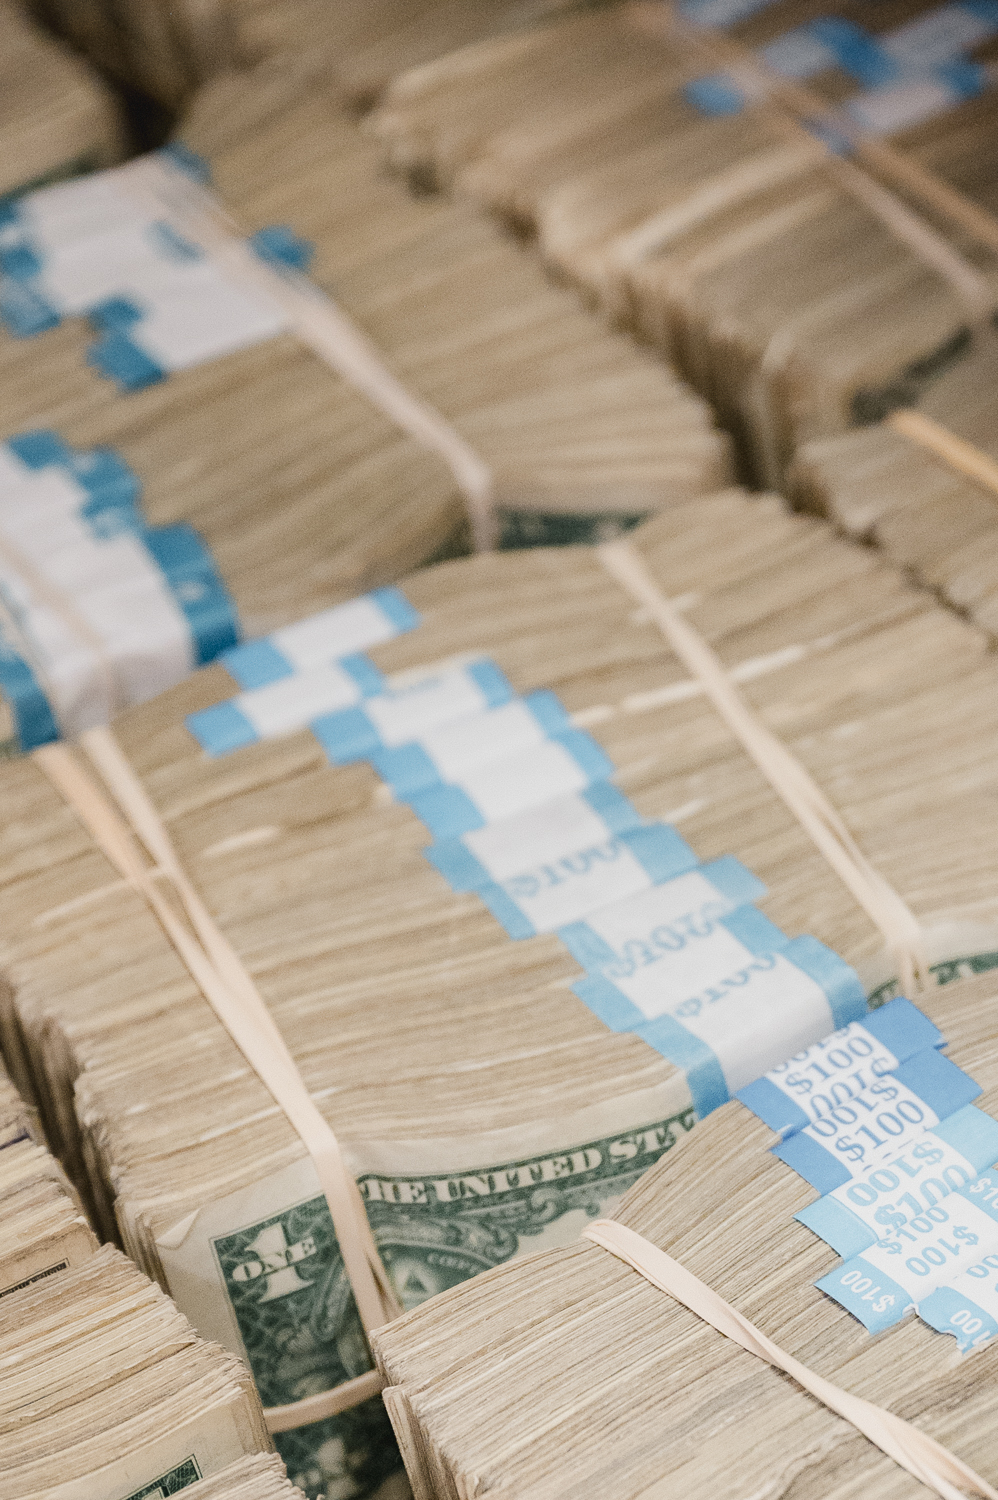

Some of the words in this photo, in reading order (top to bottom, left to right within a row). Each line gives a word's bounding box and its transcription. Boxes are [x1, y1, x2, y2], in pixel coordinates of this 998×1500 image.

[785, 1036, 873, 1095] $100
[811, 1079, 899, 1138] $100
[835, 1099, 924, 1163] $100
[433, 1147, 603, 1202] UNITED
[846, 1140, 945, 1207] $100
[877, 1206, 950, 1255] $100
[905, 1225, 979, 1277] $100
[231, 1237, 318, 1283] ONE
[840, 1269, 896, 1312] $100
